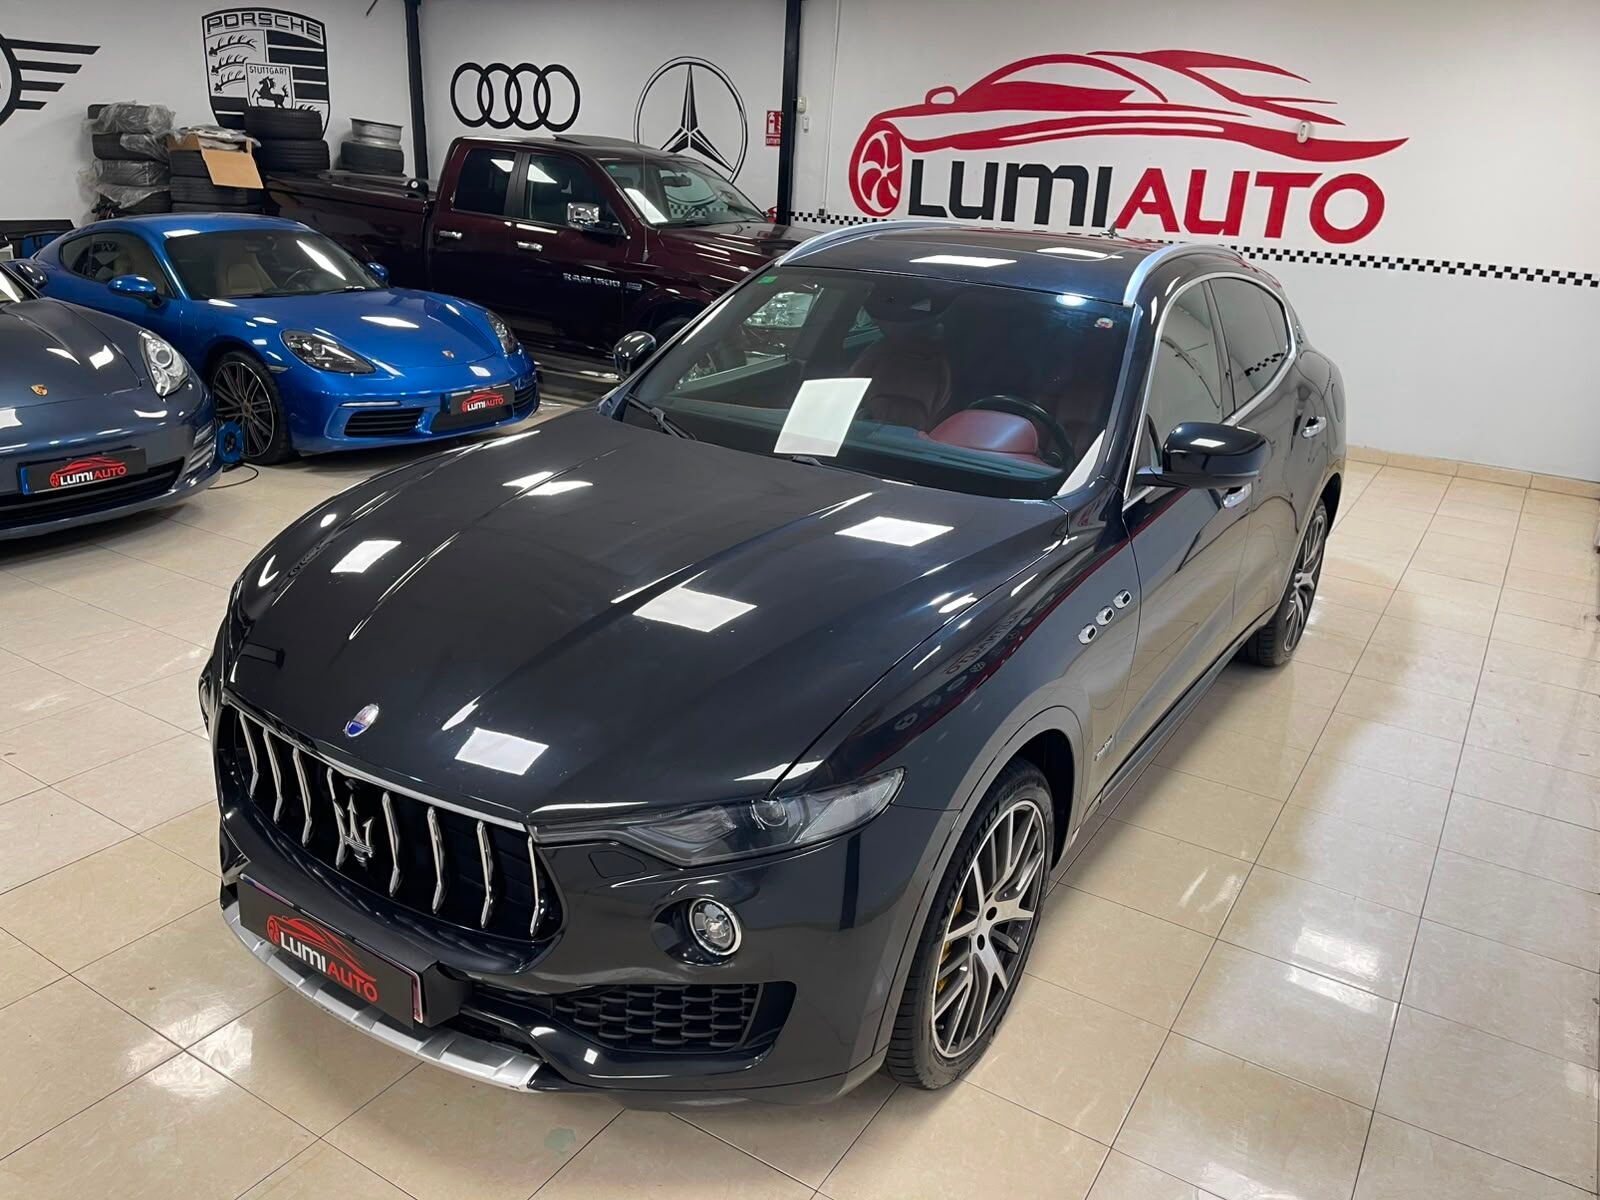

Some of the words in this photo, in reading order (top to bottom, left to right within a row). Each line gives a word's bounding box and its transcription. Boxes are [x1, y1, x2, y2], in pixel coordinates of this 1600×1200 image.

[206, 12, 321, 41] PORSCHE
[249, 65, 288, 75] STUTTGART
[562, 272, 592, 284] RAM
